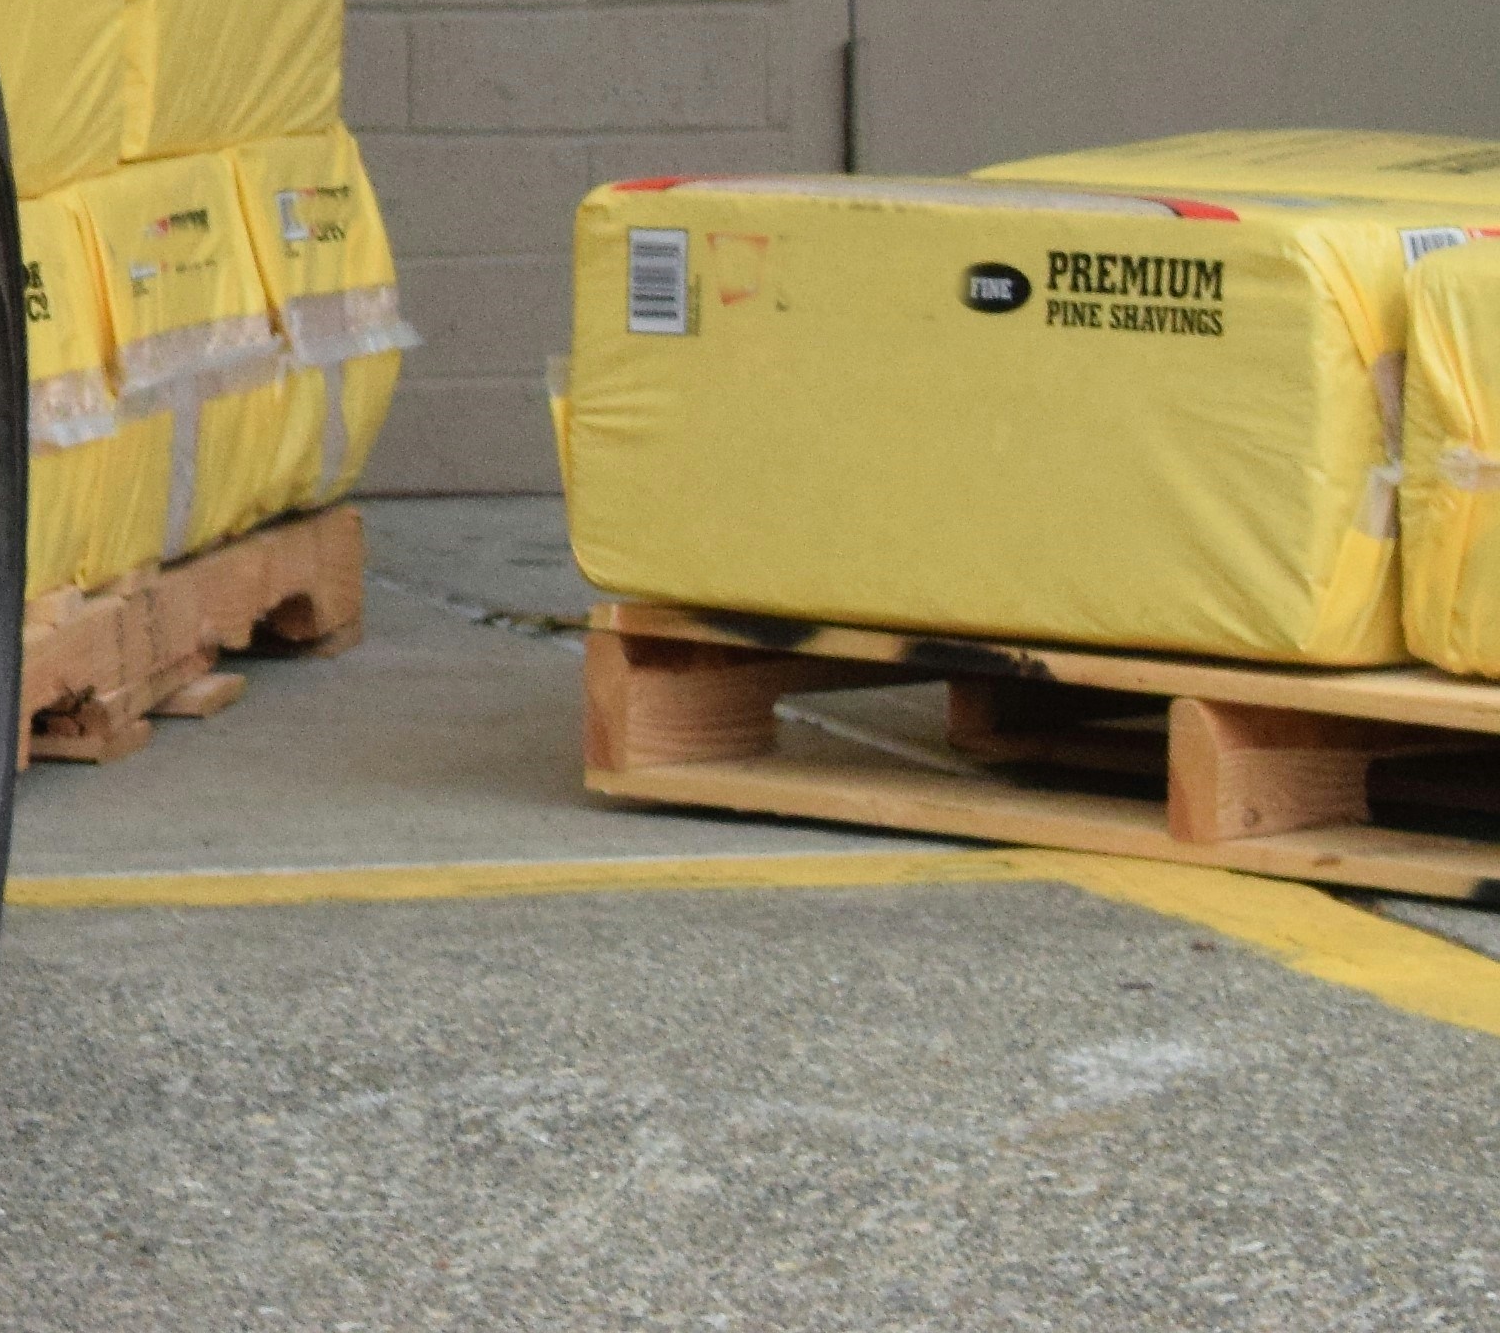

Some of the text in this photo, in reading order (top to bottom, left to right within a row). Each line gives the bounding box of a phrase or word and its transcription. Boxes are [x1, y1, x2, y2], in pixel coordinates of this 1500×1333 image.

[1048, 249, 1223, 302] PREMIUM
[1046, 299, 1223, 337] PINE SHAVINGS
